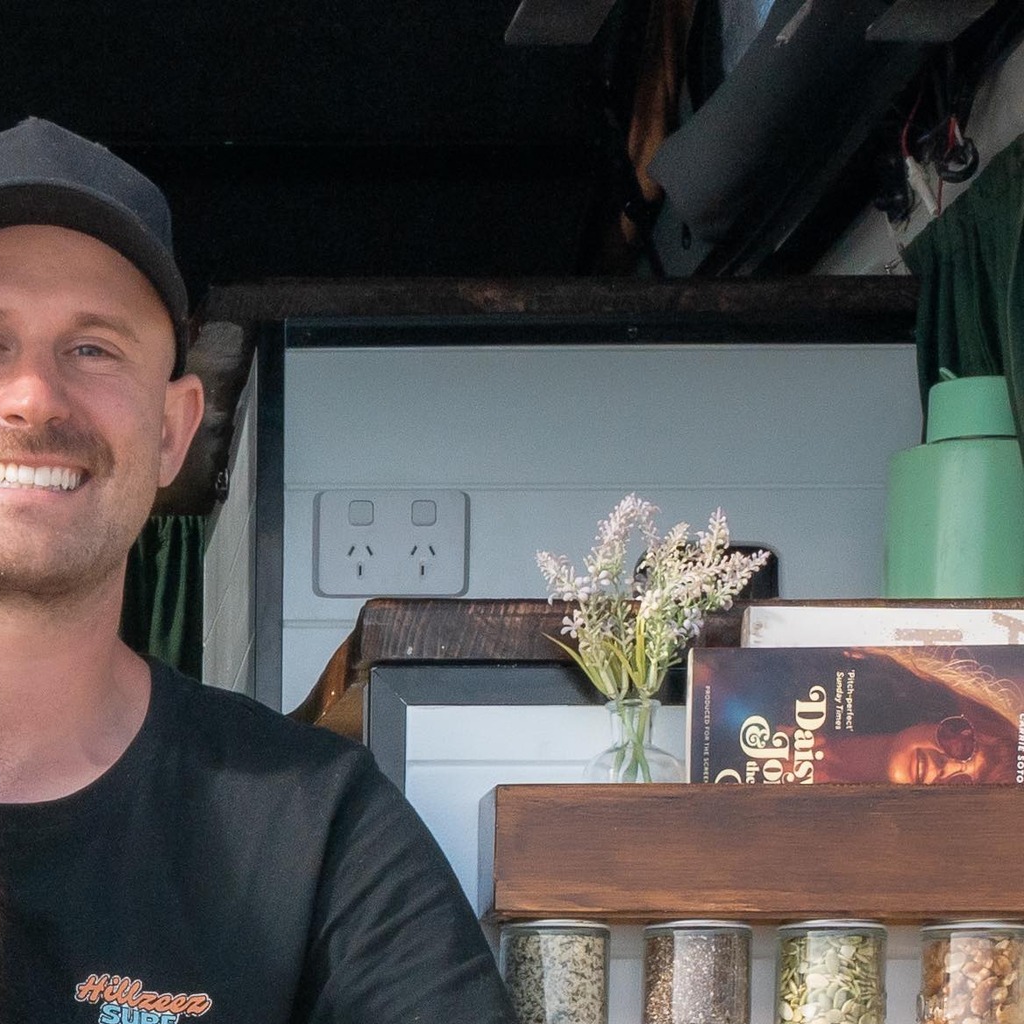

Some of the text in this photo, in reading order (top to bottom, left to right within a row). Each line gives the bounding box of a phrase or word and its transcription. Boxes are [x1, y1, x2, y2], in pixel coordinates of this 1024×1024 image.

[835, 671, 845, 730] Sunday Times
[1016, 755, 1024, 783] SOTO
